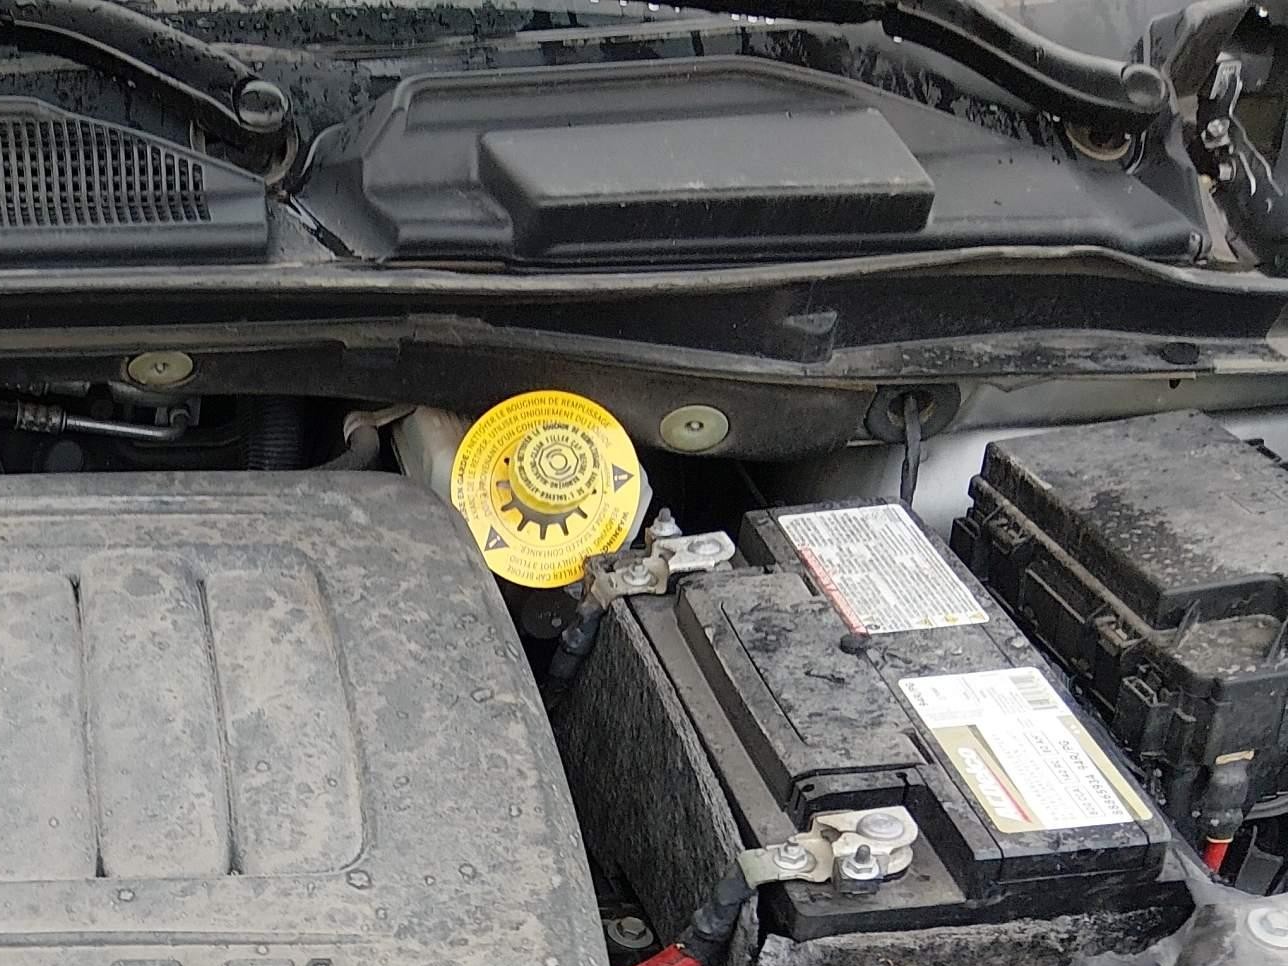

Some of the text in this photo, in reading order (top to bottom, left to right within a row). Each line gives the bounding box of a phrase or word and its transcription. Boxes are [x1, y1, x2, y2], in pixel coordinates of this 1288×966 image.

[505, 397, 546, 413] BOUCHON
[549, 397, 558, 406] DE
[561, 399, 610, 429] REMPLISSAGE
[520, 407, 574, 421] UNIQUEMENT
